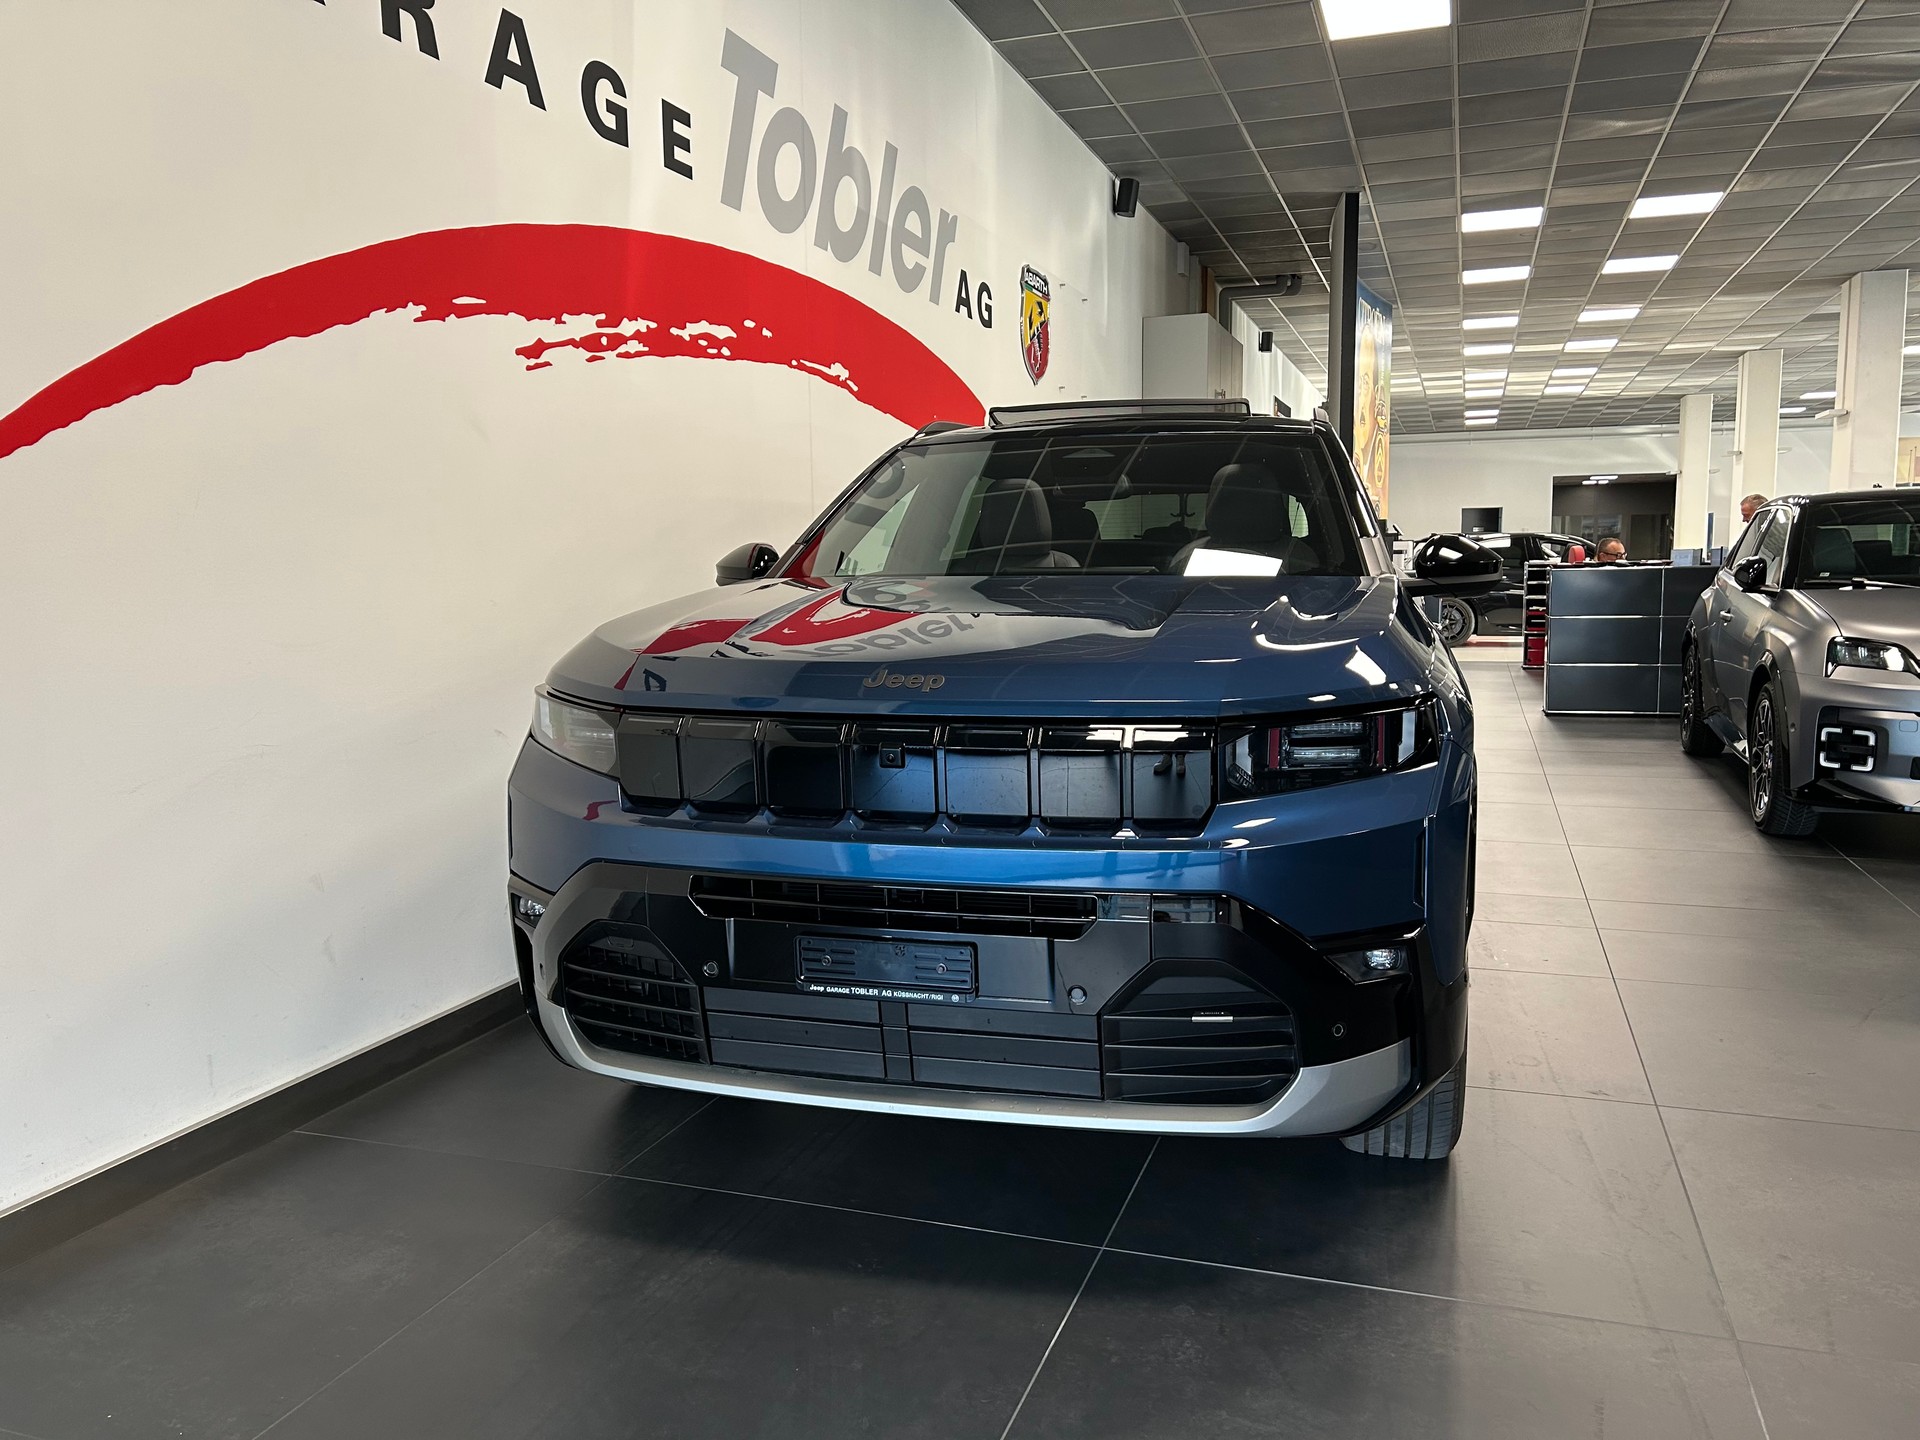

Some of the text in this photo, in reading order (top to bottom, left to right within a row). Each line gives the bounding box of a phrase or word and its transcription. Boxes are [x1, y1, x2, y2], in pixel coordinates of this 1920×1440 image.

[720, 27, 958, 305] Tobler
[955, 269, 993, 329] AG
[1024, 272, 1048, 295] ABARTH
[863, 669, 945, 692] Jeep
[809, 984, 825, 992] Jeep
[826, 986, 850, 994] GARAGE
[850, 987, 879, 996] TOBLER
[881, 989, 892, 997] AG
